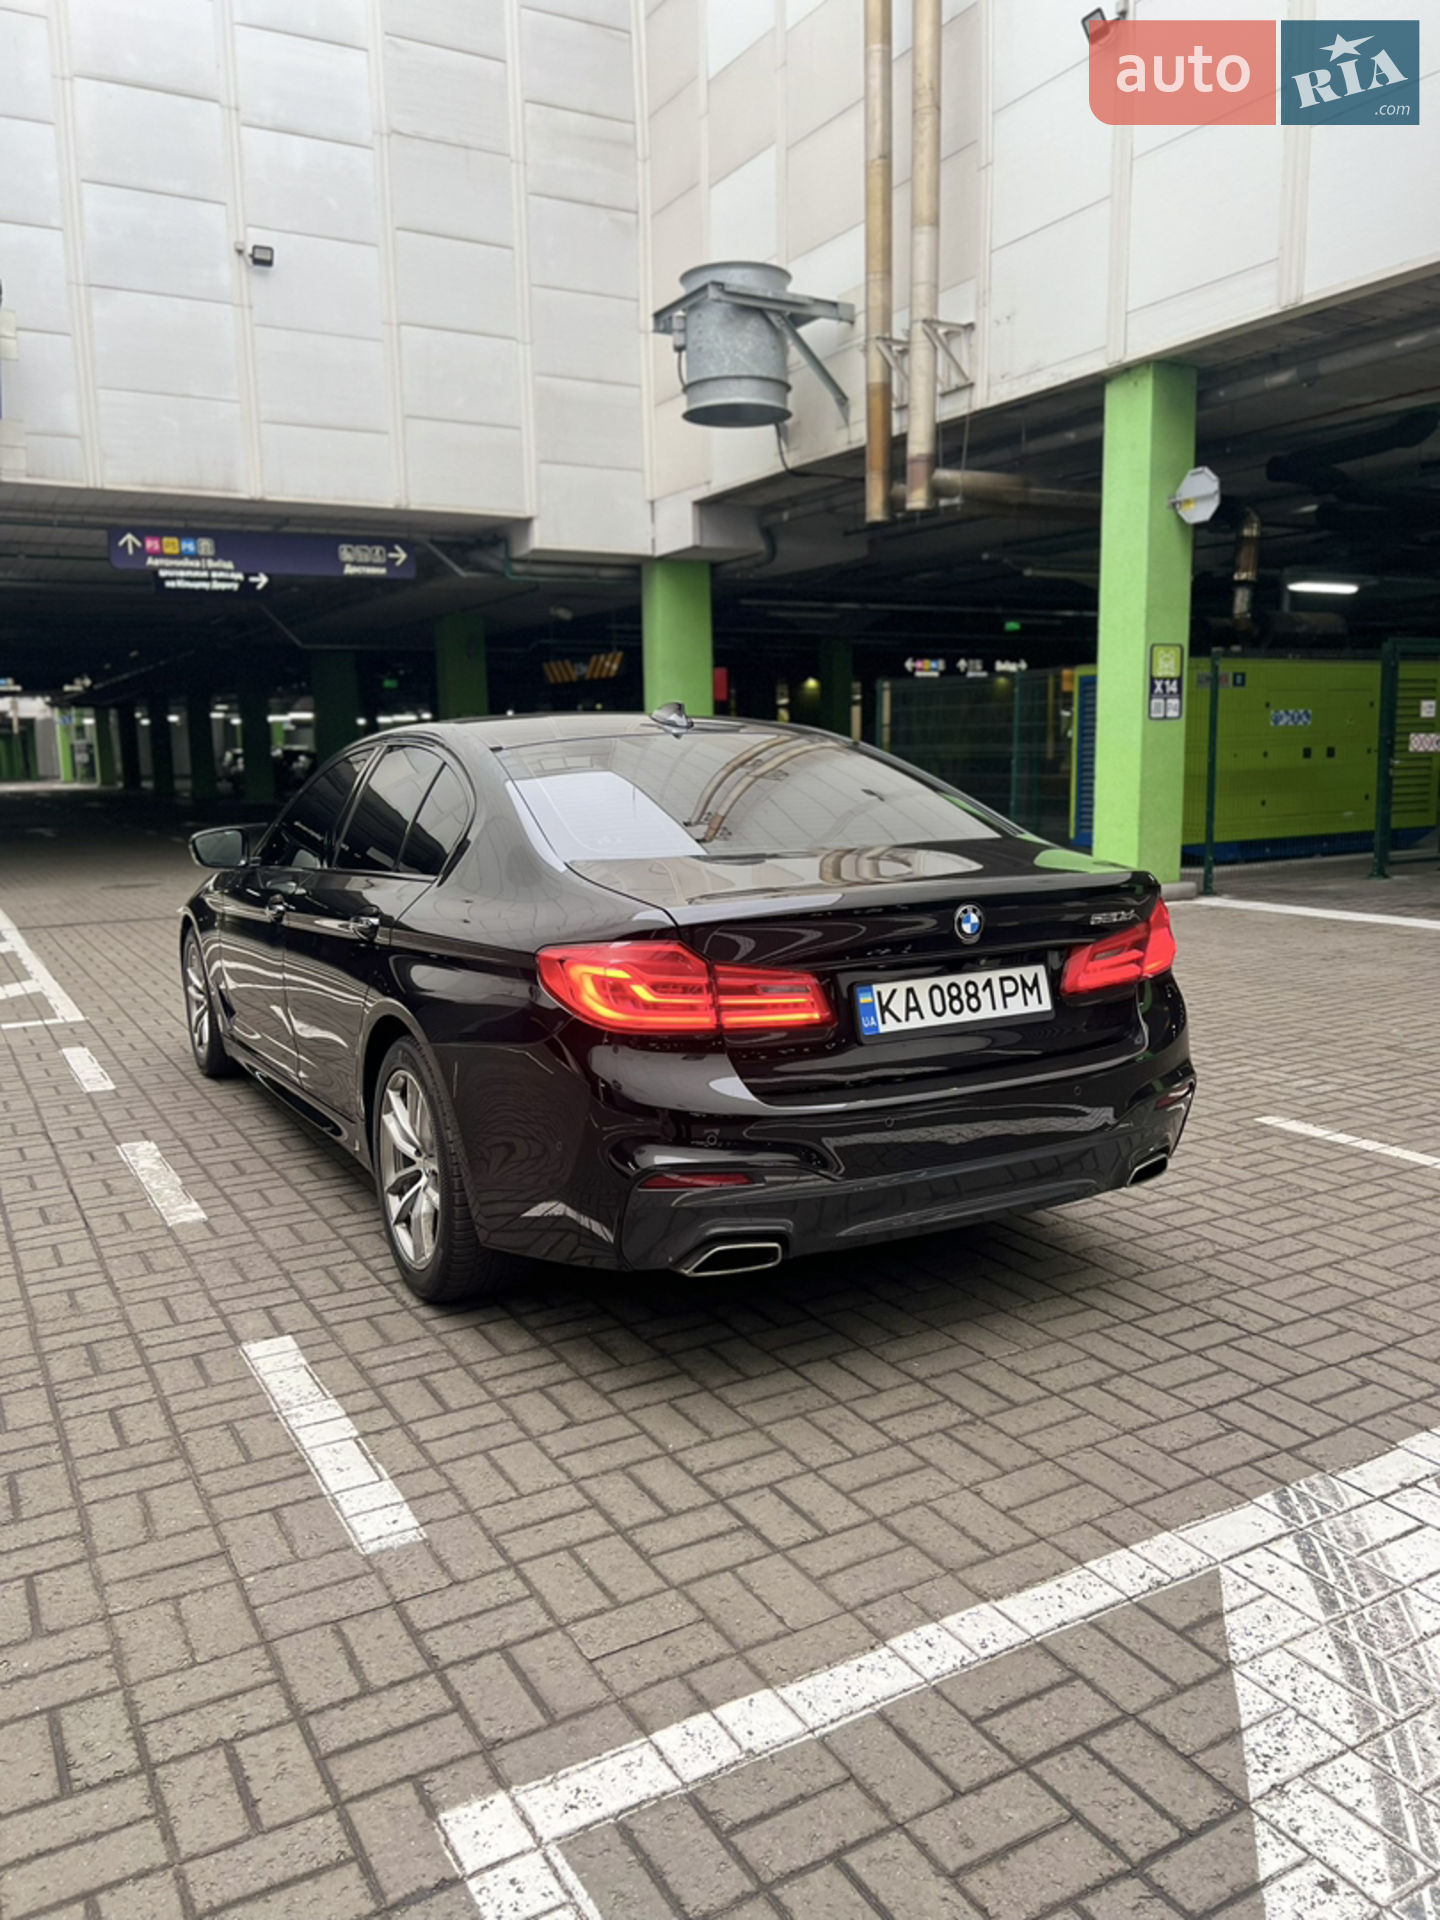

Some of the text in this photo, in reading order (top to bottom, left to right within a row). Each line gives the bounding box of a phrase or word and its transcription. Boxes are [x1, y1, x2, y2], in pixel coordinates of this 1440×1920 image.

[876, 972, 1043, 1025] KA 0881 PM
[862, 1015, 877, 1028] UA
